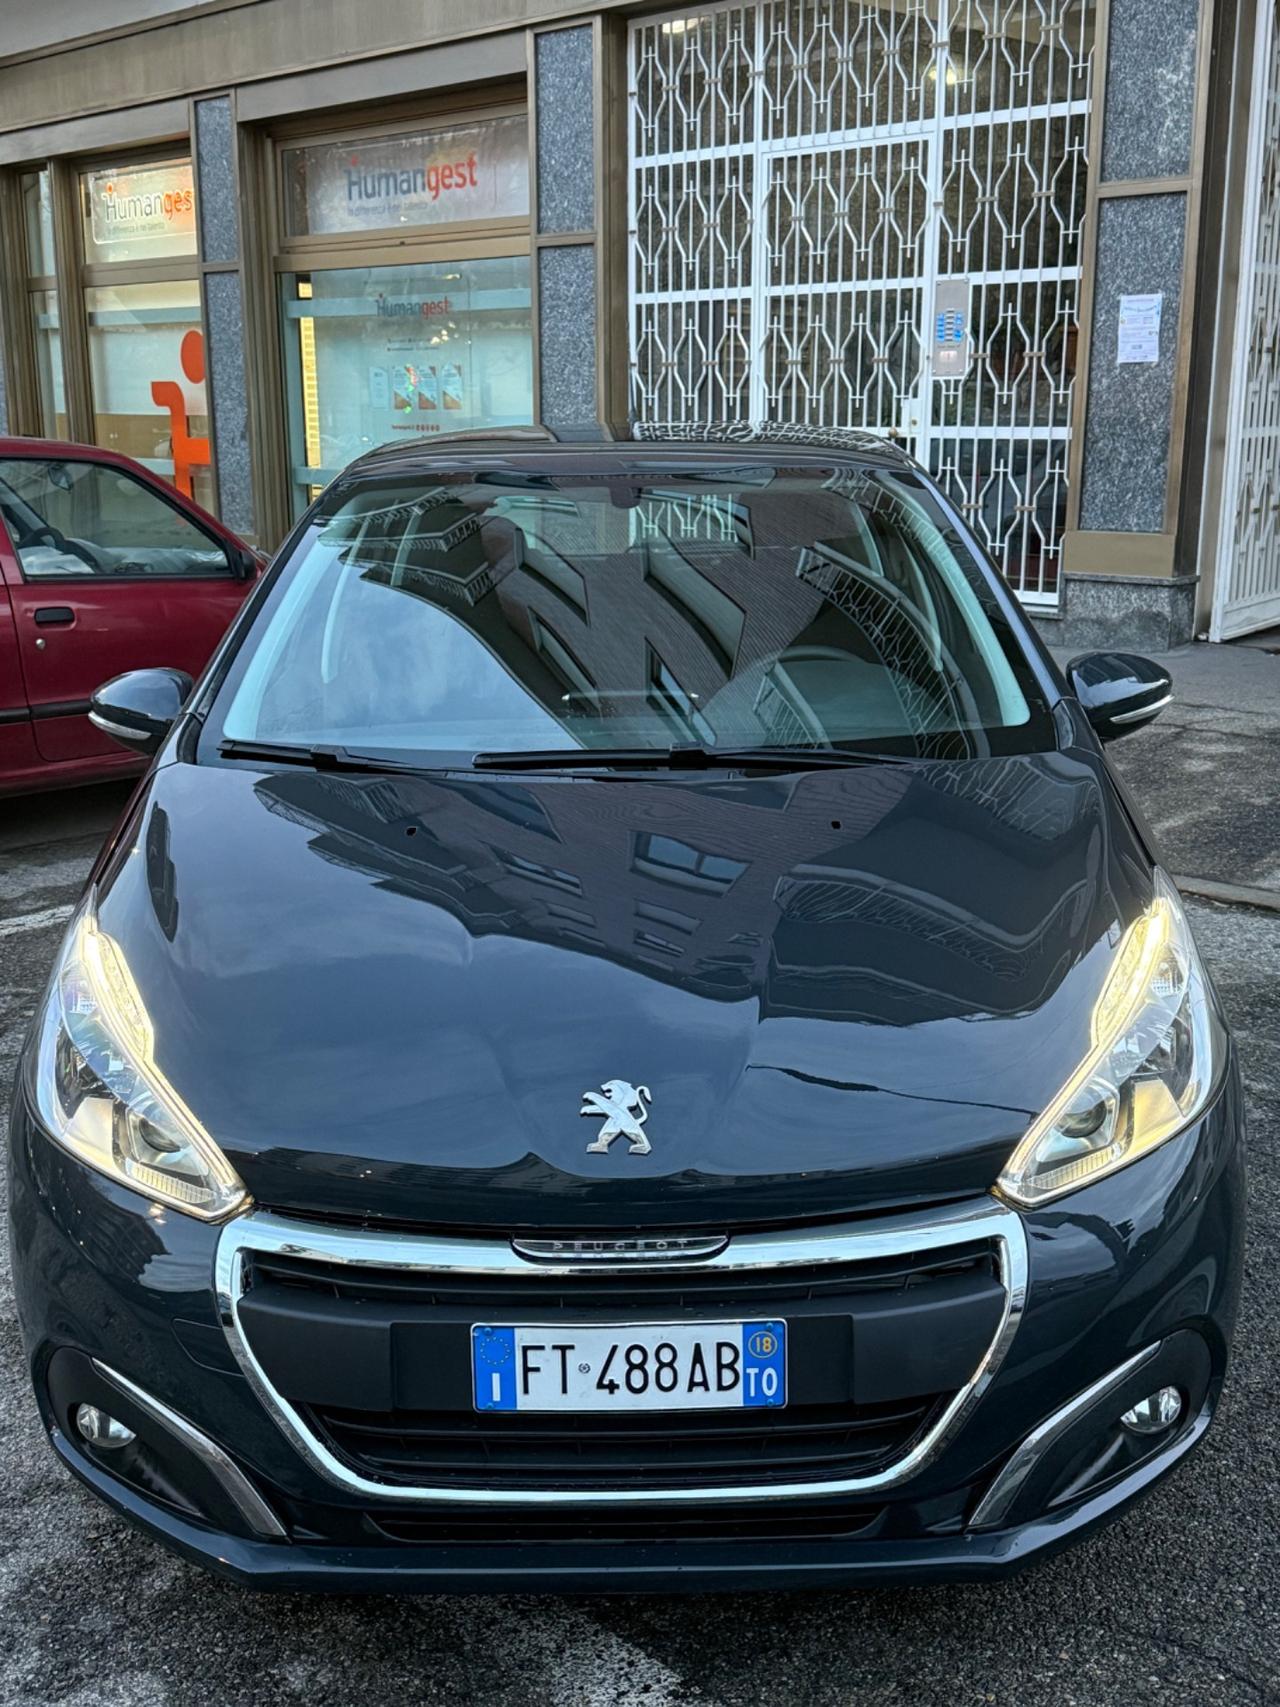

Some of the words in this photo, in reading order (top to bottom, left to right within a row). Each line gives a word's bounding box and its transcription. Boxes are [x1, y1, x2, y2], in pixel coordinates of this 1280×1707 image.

[345, 152, 478, 201] Humangest
[102, 183, 193, 222] Humanges
[376, 294, 449, 320] Humangest
[553, 1240, 688, 1251] PEUGEOT
[756, 1337, 772, 1353] 18
[521, 1344, 576, 1395] FT
[596, 1341, 740, 1395] 488AB
[491, 1373, 501, 1402] I
